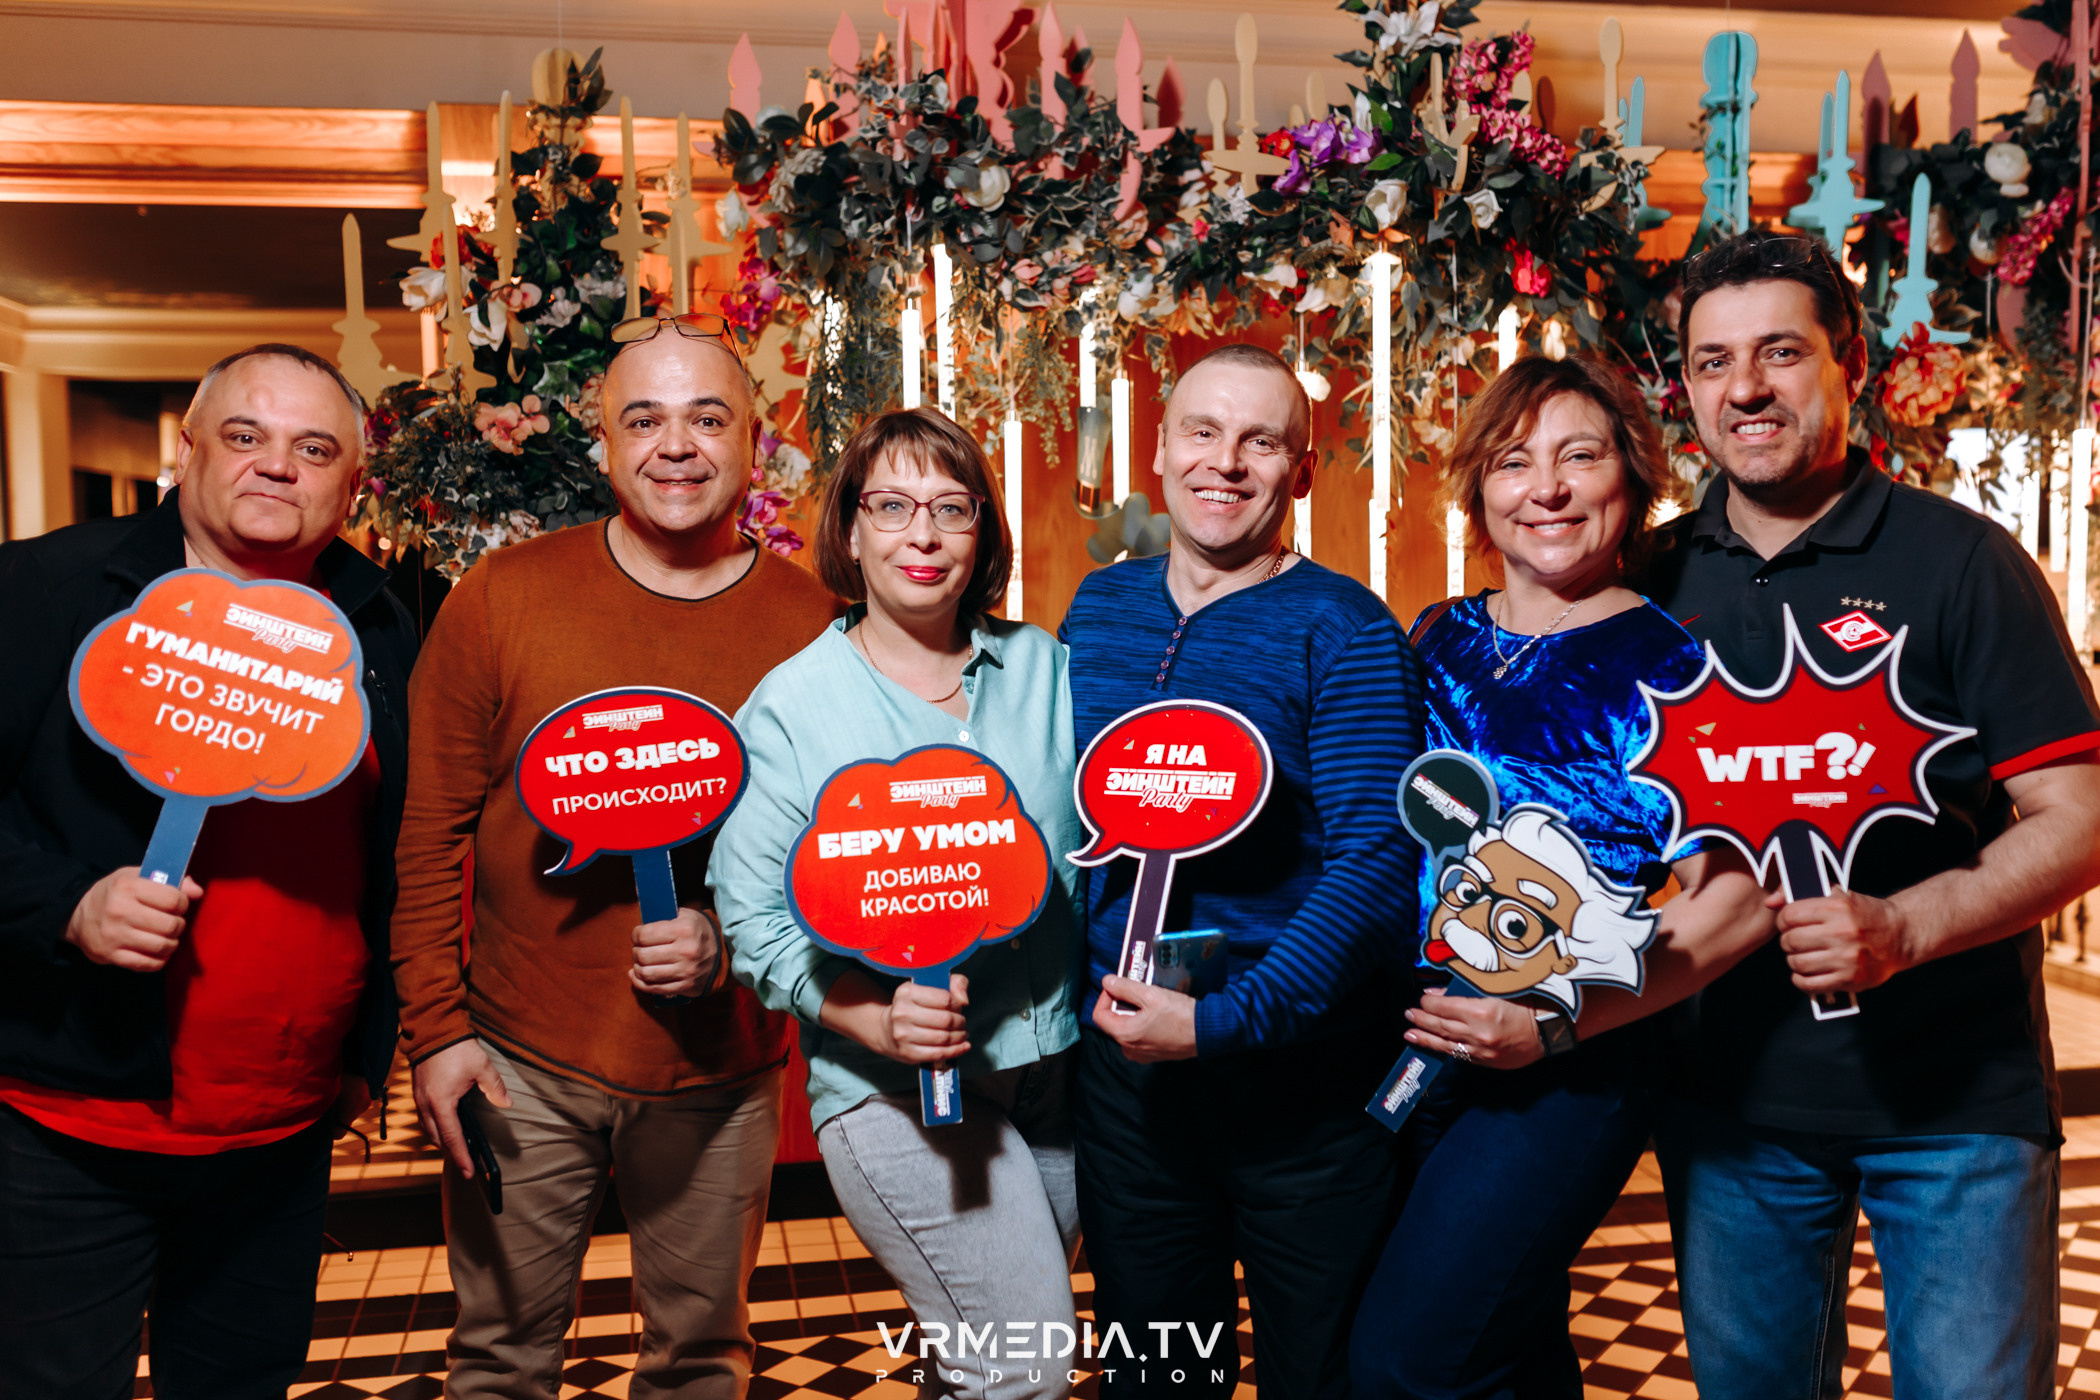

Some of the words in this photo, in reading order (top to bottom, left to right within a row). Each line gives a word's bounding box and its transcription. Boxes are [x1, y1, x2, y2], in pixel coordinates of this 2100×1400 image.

[251, 628, 298, 654] Party
[125, 622, 345, 705] ГУМАНИТАРИЙ
[140, 663, 205, 699] ЭТО
[208, 684, 324, 734] ЗВУЧИТ
[154, 703, 267, 755] ГОРДО!
[545, 751, 609, 777] ЧТО
[614, 738, 721, 770] ЗДЕСЬ
[1144, 743, 1166, 764] Я
[1166, 744, 1208, 766] НА
[1696, 731, 1877, 782] WTF?!
[552, 777, 728, 815] ПРОИСХОДИТ?
[920, 793, 960, 809] Party
[1139, 788, 1195, 813] Party
[817, 827, 906, 859] БЕРУ
[911, 819, 1016, 851] УМОМ
[863, 861, 981, 893] ДОБИВАЮ
[860, 885, 990, 918] КРАСОТОЙ!
